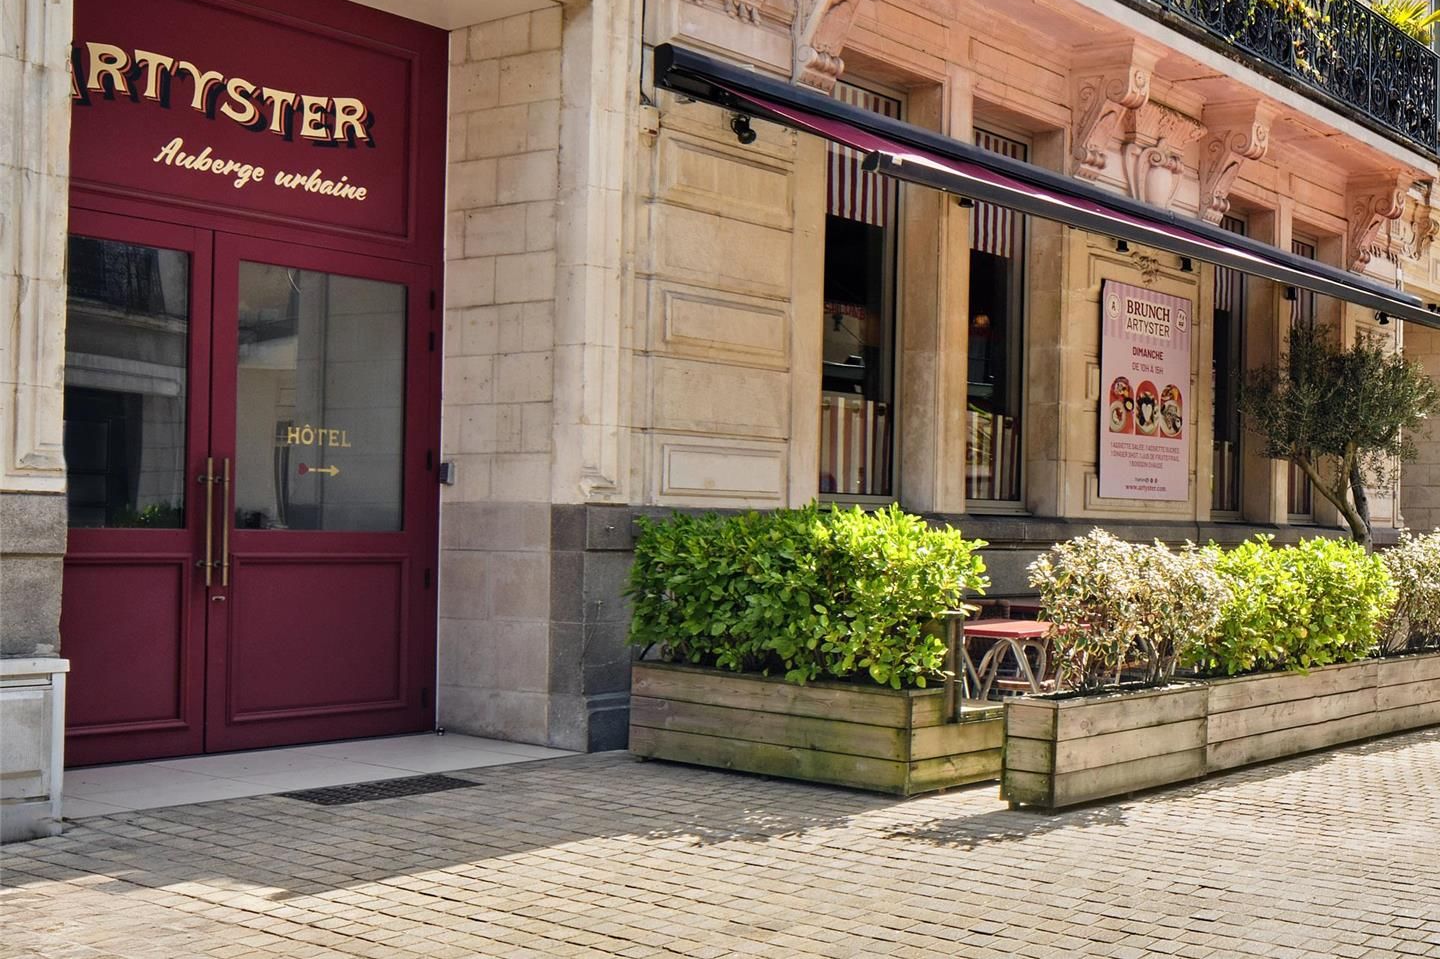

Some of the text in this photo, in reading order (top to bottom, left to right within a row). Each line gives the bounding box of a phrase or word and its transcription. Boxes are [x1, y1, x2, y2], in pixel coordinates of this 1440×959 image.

[153, 137, 367, 201] Auberge urbaine
[1127, 300, 1170, 322] BRUNCH
[1127, 318, 1170, 337] ARTYSTER
[1132, 346, 1164, 360] DIMANCHE
[287, 424, 351, 447] HÔTEL
